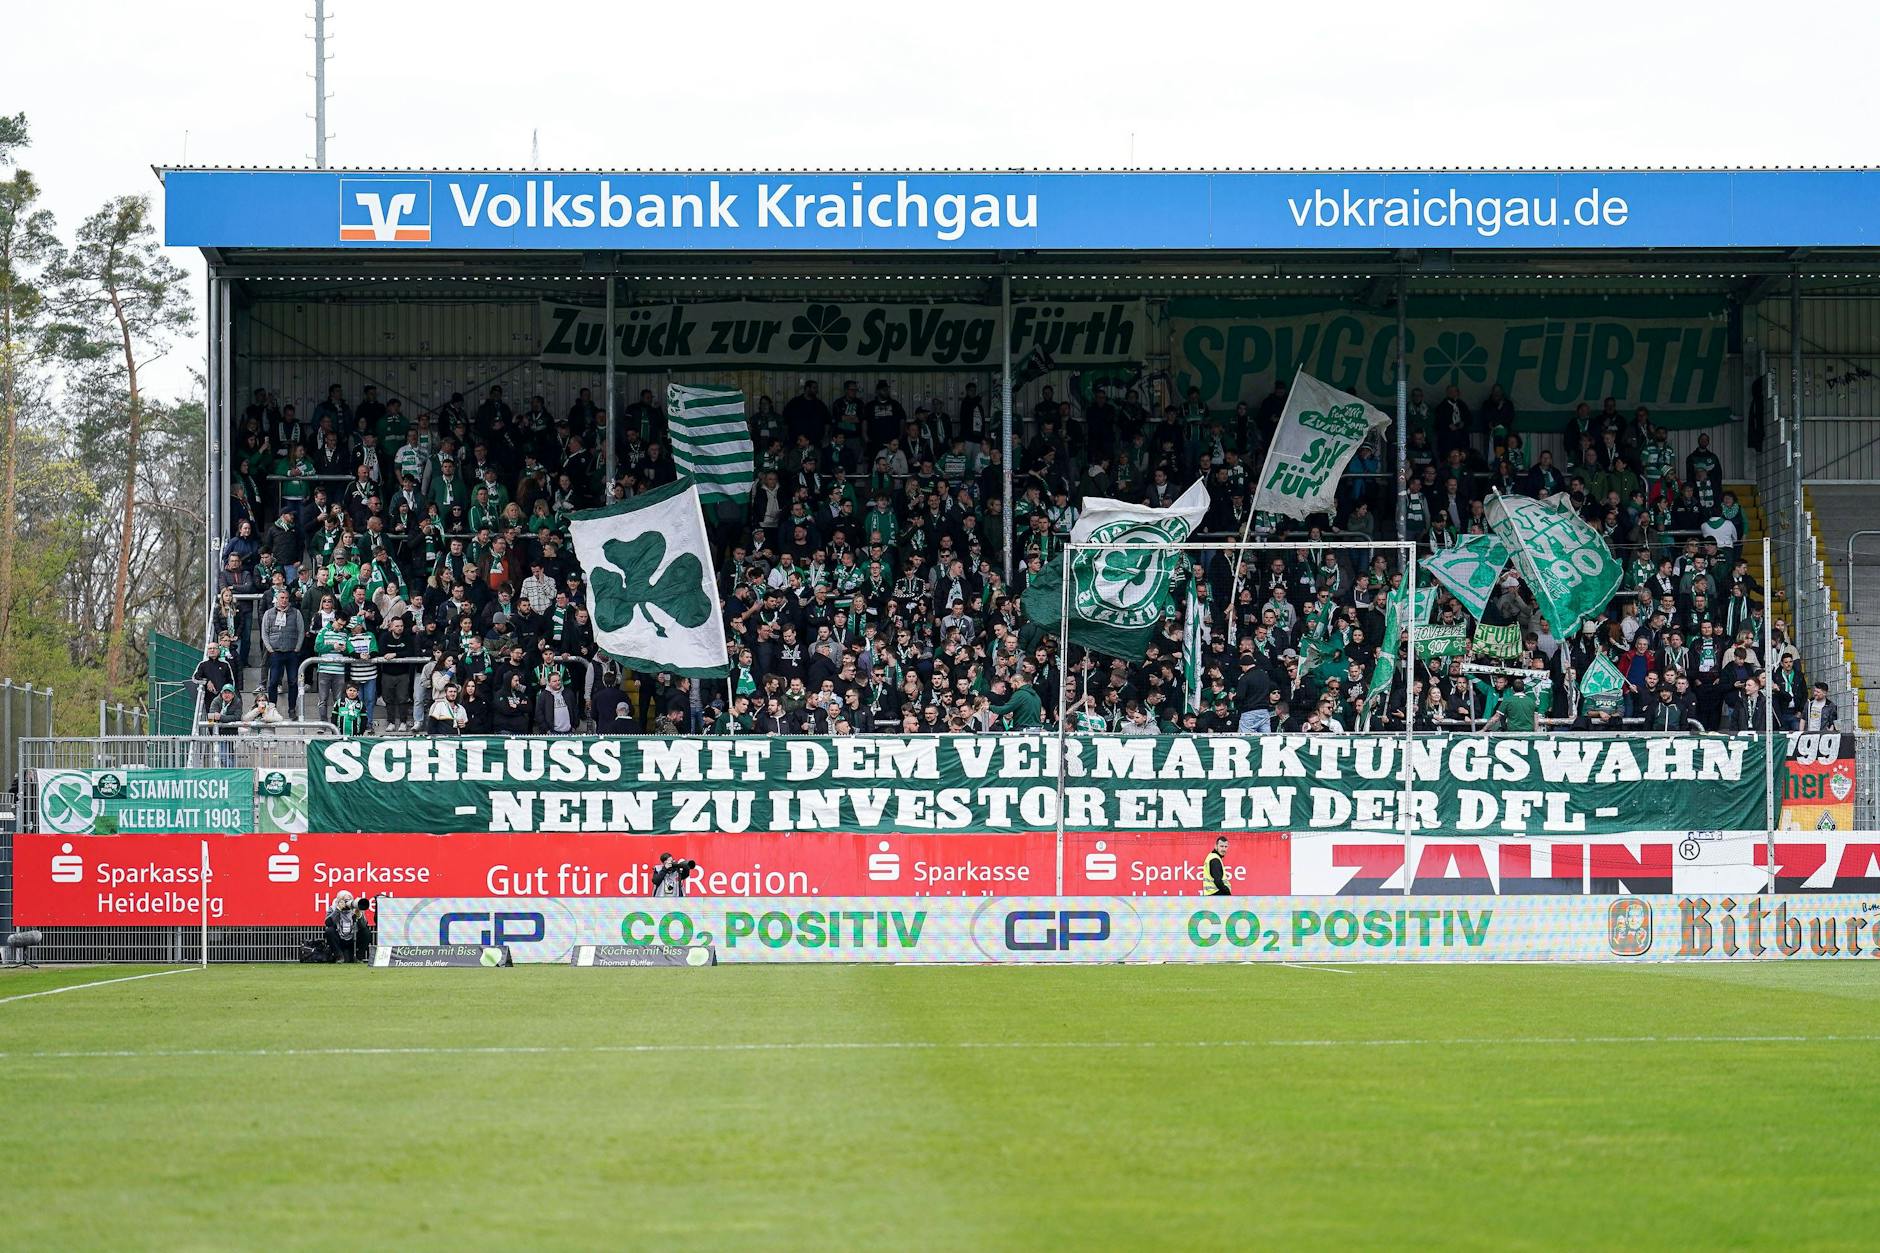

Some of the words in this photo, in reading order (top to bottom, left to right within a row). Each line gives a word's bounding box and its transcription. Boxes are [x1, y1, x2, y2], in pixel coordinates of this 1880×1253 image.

[449, 180, 739, 229] Volksbank
[757, 181, 1039, 241] Kraichgau
[1288, 188, 1629, 237] vbkraichgau.de
[543, 306, 697, 360] Zurück
[706, 319, 781, 355] zur
[857, 307, 995, 363] SpVgg
[1010, 304, 1135, 357] Fürth
[1176, 315, 1416, 410] SPVGG
[1498, 321, 1728, 406] FÜRTH
[325, 740, 622, 783] SCHLUSS
[637, 740, 771, 782] MIT
[786, 738, 940, 781] DEM
[952, 736, 1749, 783] VERMARKTUNGSWAHN
[129, 779, 229, 800] STAMMTISCH
[118, 809, 201, 829] KLEEBLATT
[205, 808, 242, 829] 1903
[489, 790, 658, 832] NEIN
[670, 790, 756, 833] ZU
[768, 787, 1208, 831] INVESTOREN
[1221, 786, 1296, 830] IN
[1309, 788, 1442, 831] DER
[1456, 790, 1586, 832] DFL
[97, 863, 213, 889] Sparkasse
[314, 862, 430, 888] Sparkasse
[486, 865, 548, 896] Gut
[558, 864, 612, 896] für
[618, 864, 650, 896] di
[685, 865, 820, 897] Region.
[914, 861, 1030, 886] Sparkasse
[1131, 861, 1247, 886] Sparkase
[440, 912, 545, 947] GP
[726, 911, 927, 948] POSITIV
[1005, 910, 1110, 951] GP
[1292, 910, 1493, 948] POSITIV
[396, 946, 434, 956] Küchen
[438, 946, 454, 956] mit
[457, 946, 477, 956] Biss
[600, 945, 639, 955] Küchen
[642, 945, 659, 955] mit
[662, 945, 682, 955] Biss
